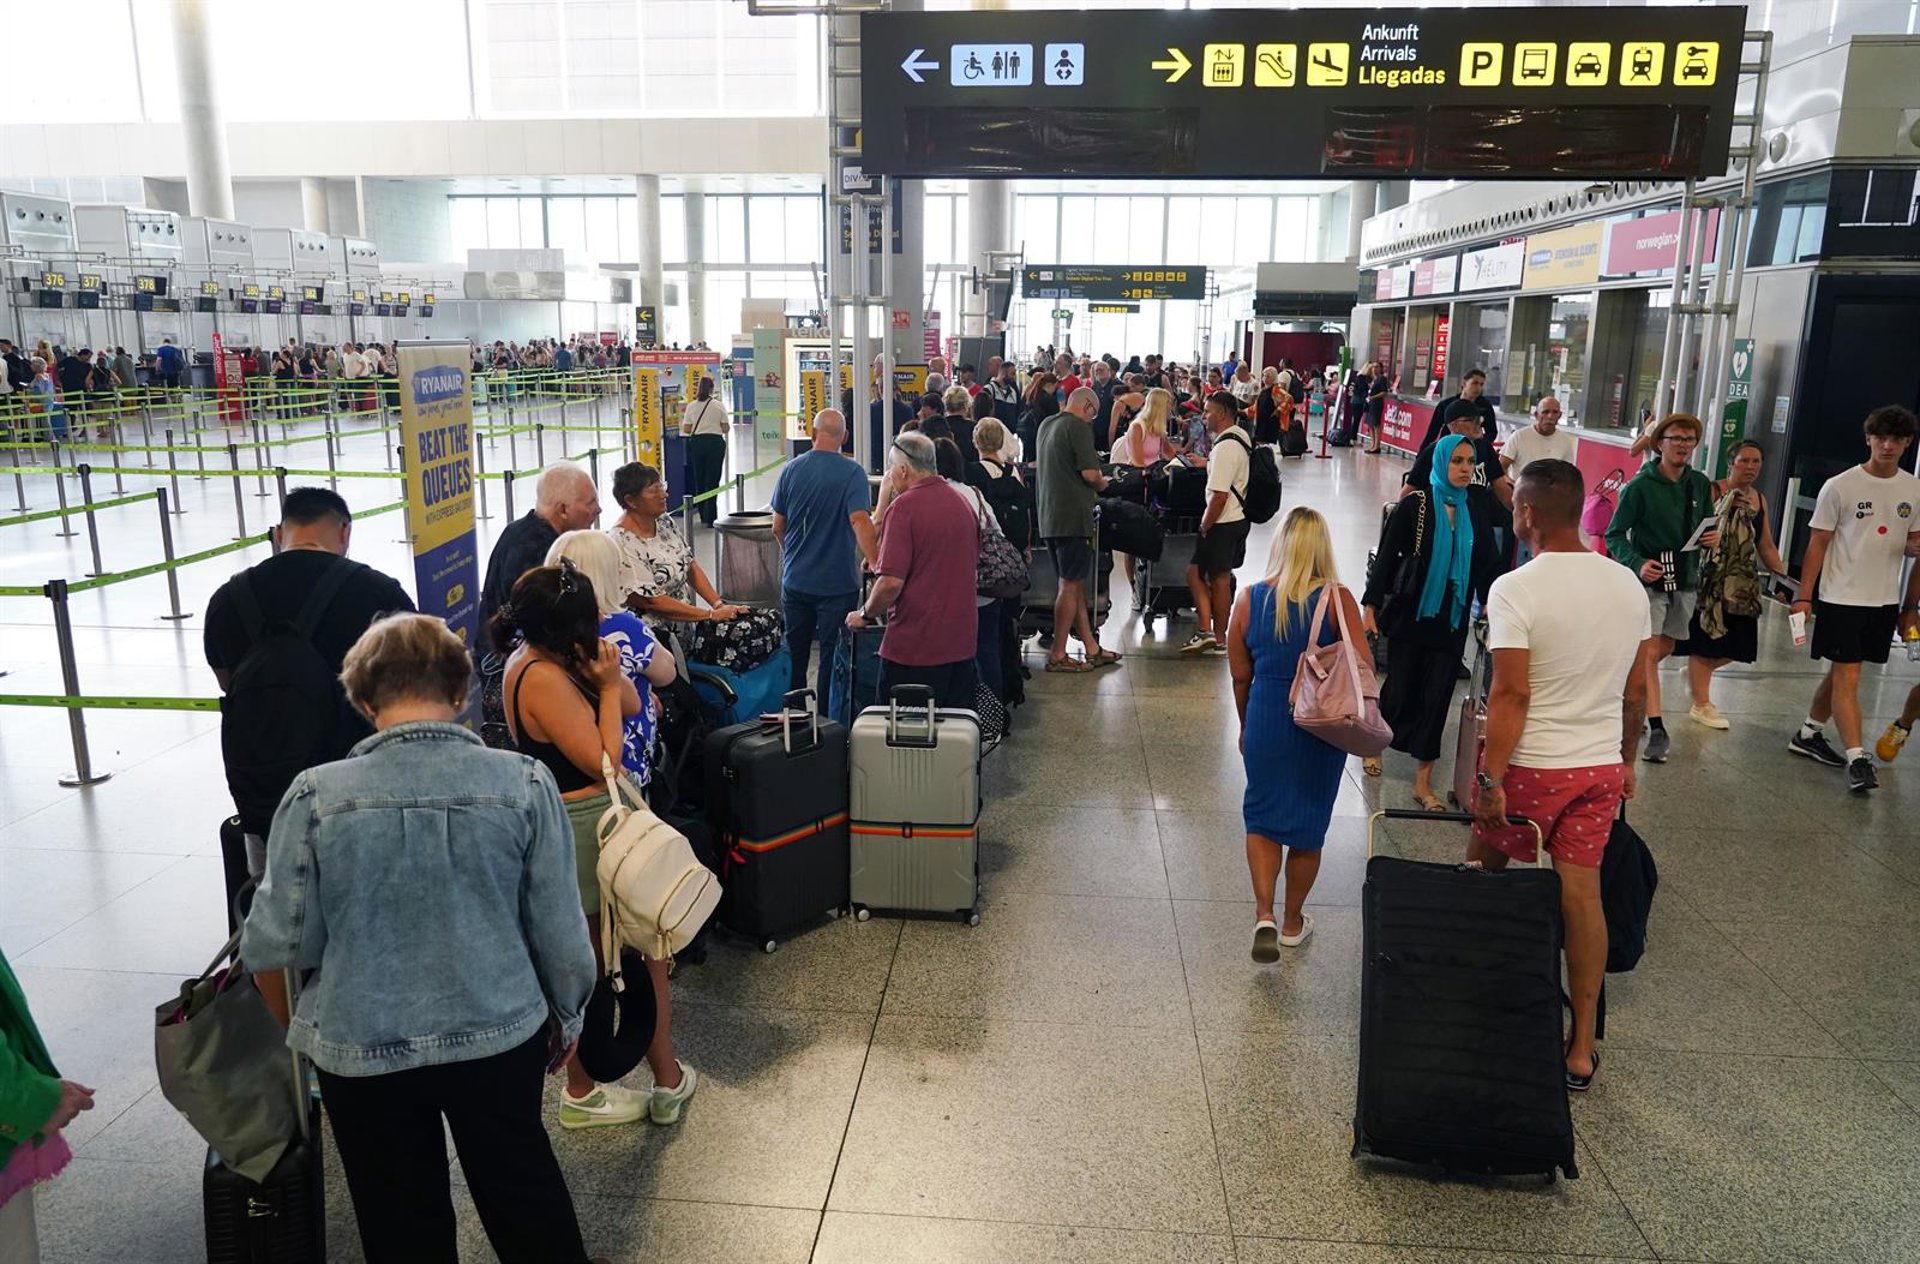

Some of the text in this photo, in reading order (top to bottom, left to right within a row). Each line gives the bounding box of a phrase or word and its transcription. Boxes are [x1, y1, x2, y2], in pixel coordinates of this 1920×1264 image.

[1361, 24, 1419, 40] Ankunft
[1360, 45, 1417, 61] Arrivals
[1359, 66, 1446, 88] Llegadas
[45, 273, 65, 286] 376
[83, 276, 100, 288] 377
[138, 278, 156, 290] 378
[203, 282, 218, 293] 379
[421, 374, 462, 395] RYANAIR
[1729, 383, 1748, 396] DEA
[641, 375, 649, 425] RYANAIR
[809, 377, 818, 423] YANAIR
[1384, 404, 1412, 427] Jet2.com
[419, 423, 468, 463] BEAT THE
[422, 457, 471, 507] QUEUES
[1858, 501, 1872, 510] GR
